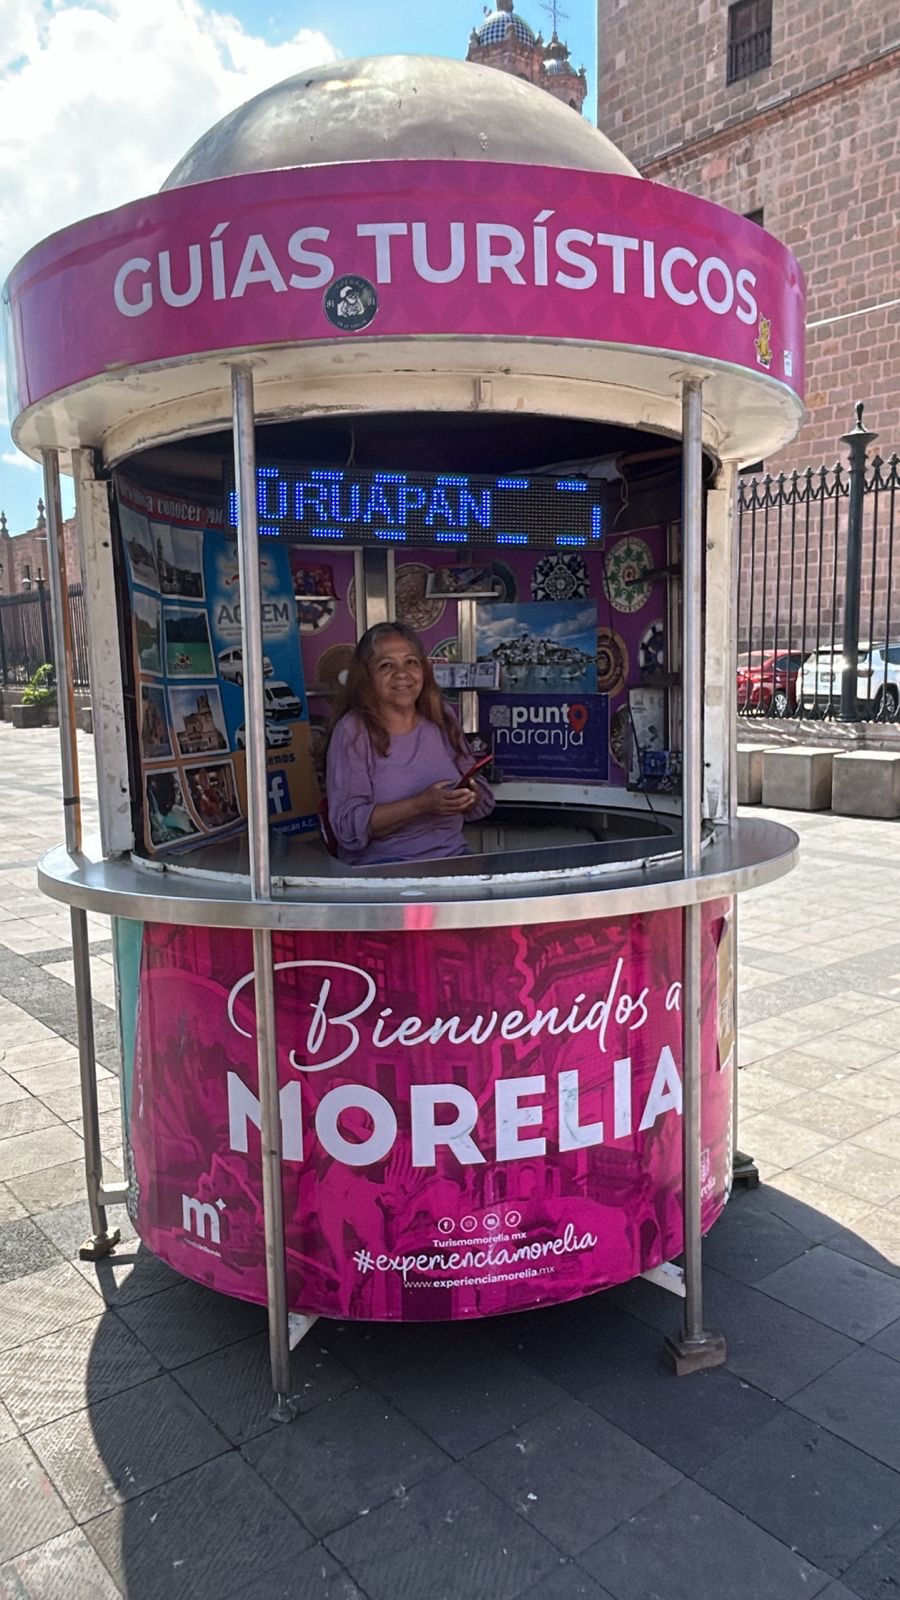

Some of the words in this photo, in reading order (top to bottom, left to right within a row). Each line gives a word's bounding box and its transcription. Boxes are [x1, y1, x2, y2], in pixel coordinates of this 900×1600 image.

[114, 221, 335, 317] GUÍAS
[356, 209, 758, 326] TURÍSTICOS
[257, 480, 491, 528] URUAPAN
[496, 724, 584, 751] naranja
[227, 958, 649, 1072] Bienvenidos
[665, 981, 683, 1011] a
[226, 1045, 683, 1168] MORELIA
[352, 1223, 598, 1281] #experienciamorelia
[403, 1265, 555, 1289] www.experienciamorelia.mx
